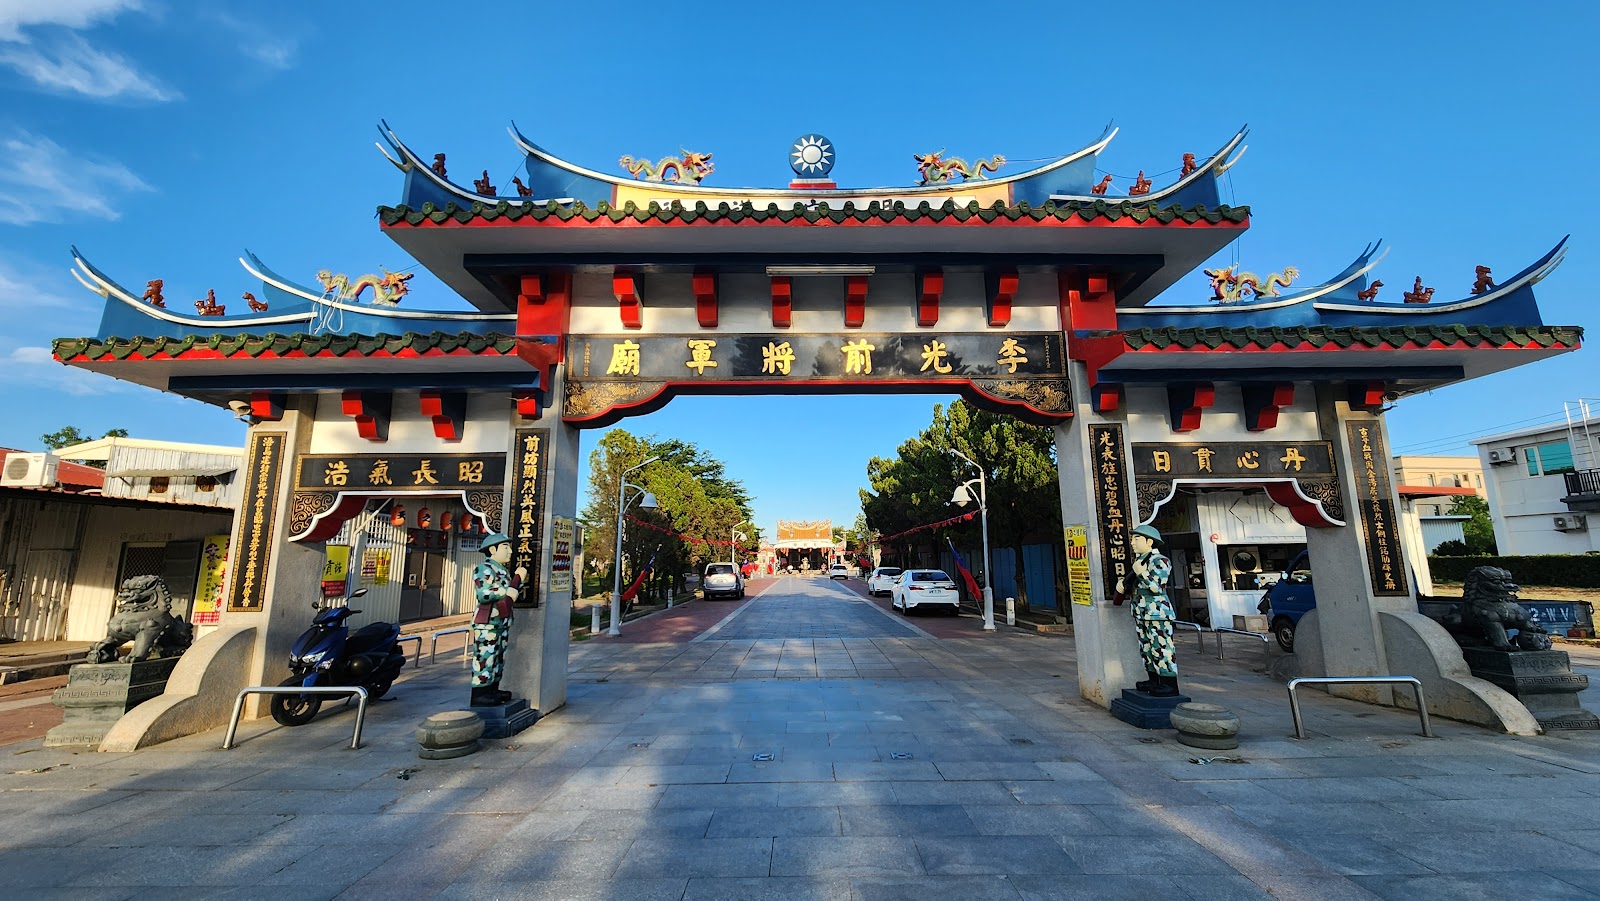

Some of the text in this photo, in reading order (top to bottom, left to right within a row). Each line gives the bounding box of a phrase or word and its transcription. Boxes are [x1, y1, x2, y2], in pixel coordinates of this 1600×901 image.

[606, 338, 1029, 376] 李光前將軍廟
[324, 458, 484, 487] 浩氣長昭
[1153, 447, 1307, 473] 丹心貫日
[515, 434, 541, 600] 前坊顯烈英風正氣壯
[1098, 430, 1127, 582] 光表旌忠碧血丹心昭日
